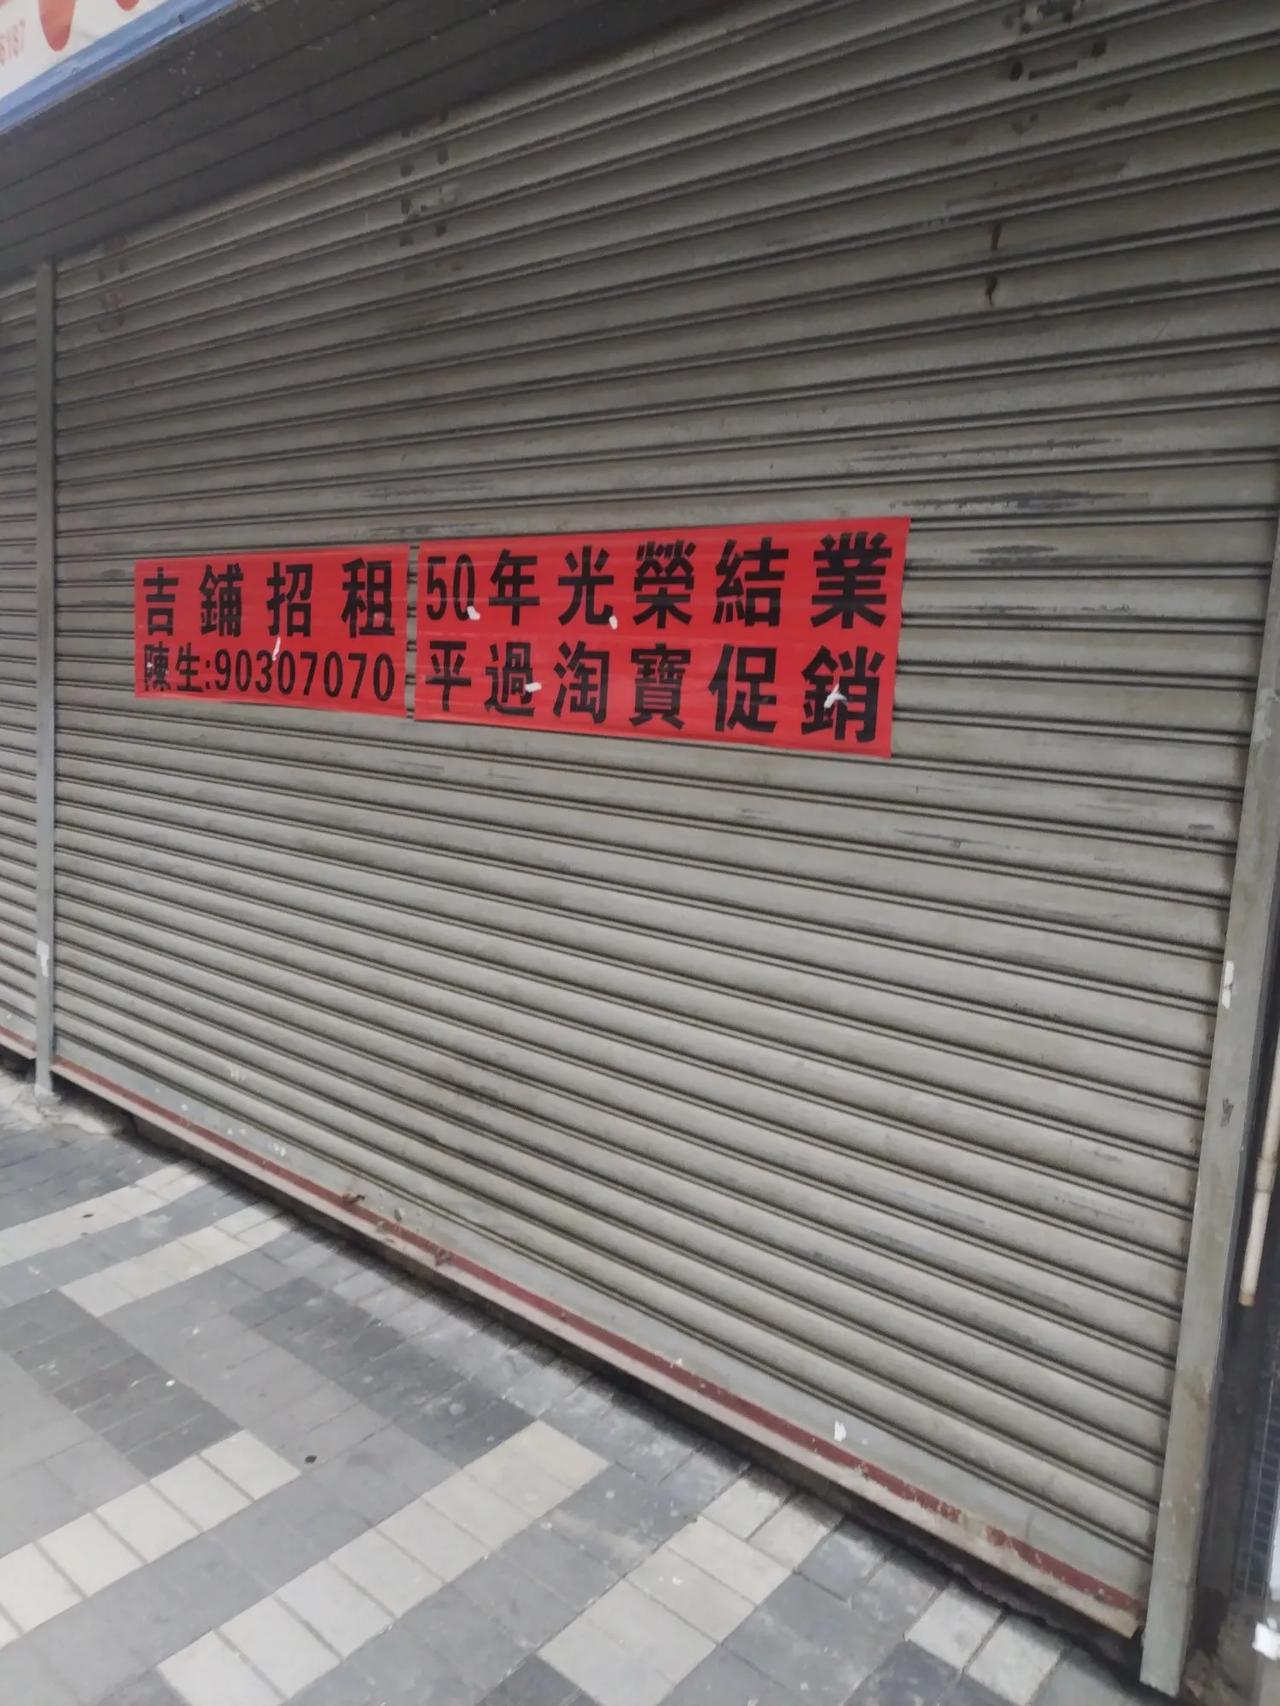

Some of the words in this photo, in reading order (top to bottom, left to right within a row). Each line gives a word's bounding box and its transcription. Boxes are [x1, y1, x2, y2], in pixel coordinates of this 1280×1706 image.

[143, 557, 396, 638] 吉鋪招租
[425, 531, 893, 630] 50年光榮結業
[425, 640, 886, 744] 平過淘寶促銷
